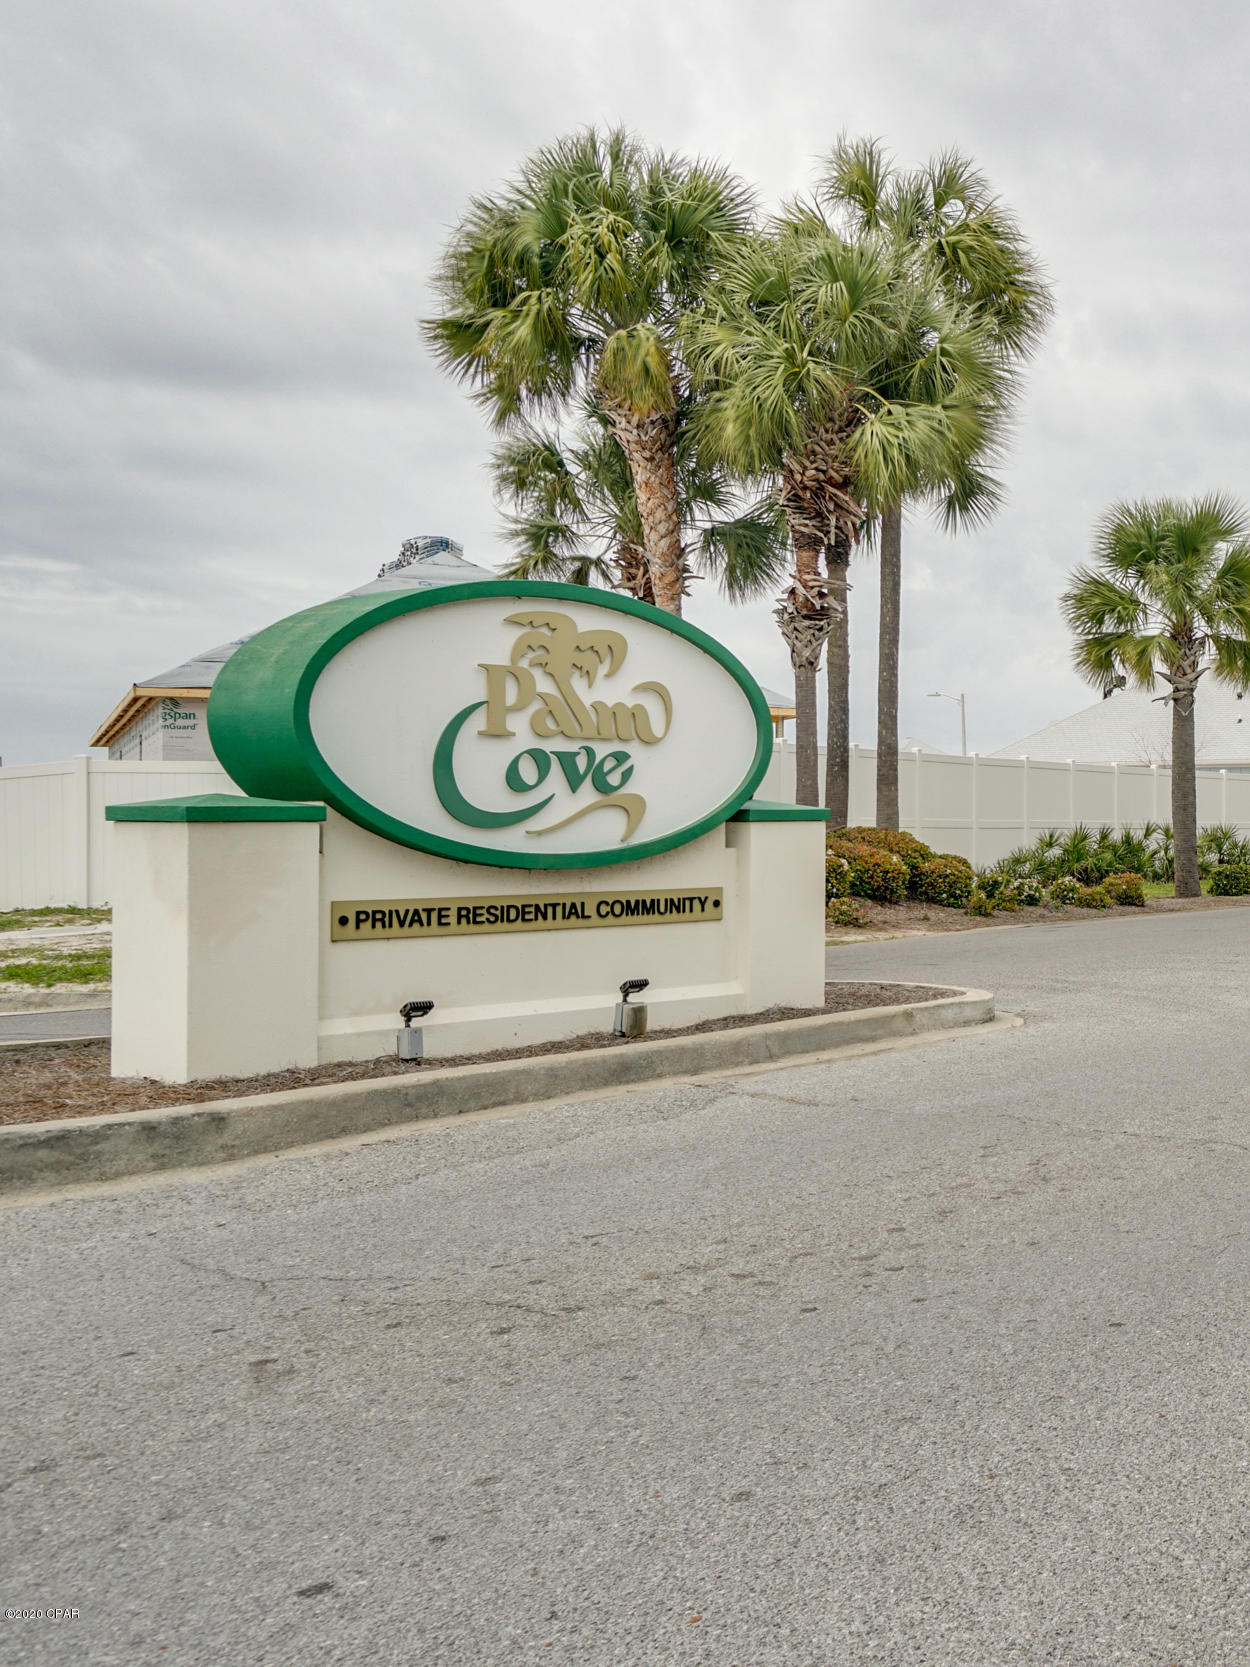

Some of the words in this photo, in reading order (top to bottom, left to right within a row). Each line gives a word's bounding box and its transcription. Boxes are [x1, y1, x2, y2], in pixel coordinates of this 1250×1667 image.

[477, 664, 673, 743] Palm
[433, 701, 634, 829] Cove
[355, 907, 451, 930] PRIVATE
[457, 902, 592, 925] RESIDENTIAL
[596, 896, 709, 918] COMMUNITY
